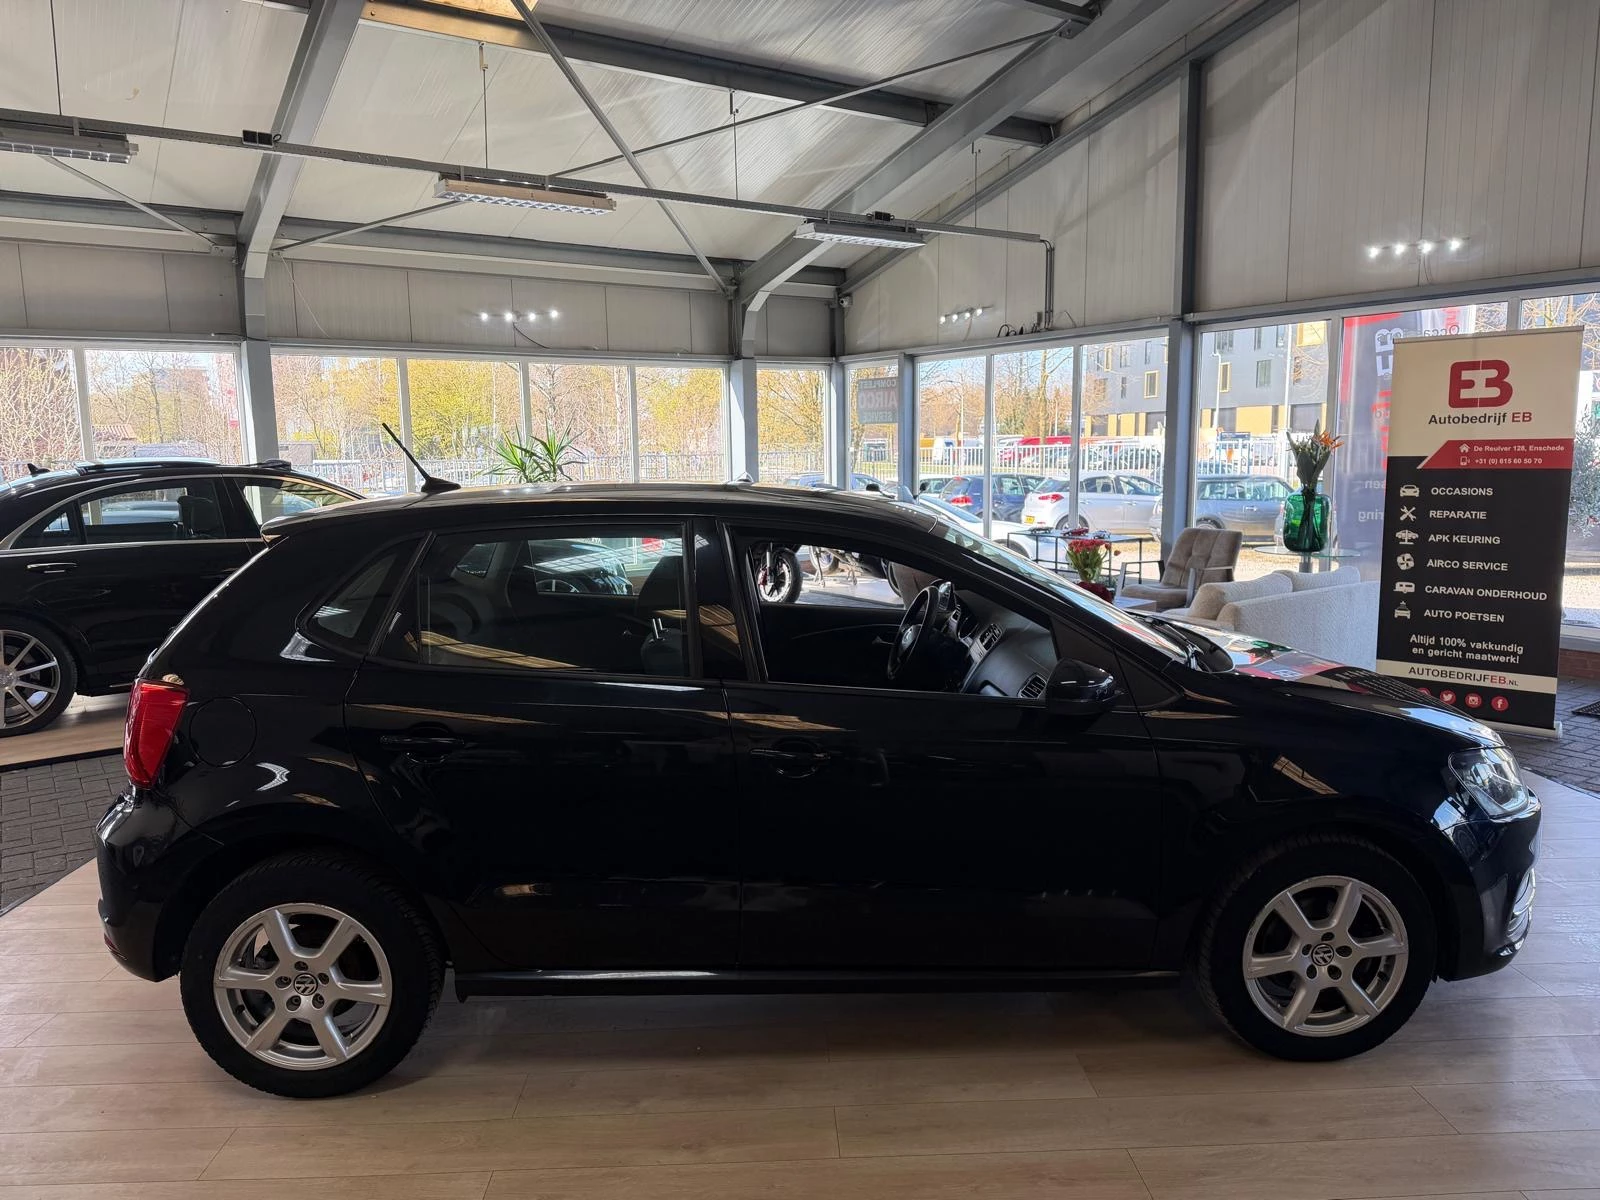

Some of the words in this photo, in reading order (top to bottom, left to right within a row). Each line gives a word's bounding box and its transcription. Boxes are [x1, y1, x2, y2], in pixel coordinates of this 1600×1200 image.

[1448, 359, 1514, 409] EB
[1428, 412, 1508, 426] Autobedrijf
[1511, 411, 1533, 423] EB
[1488, 457, 1498, 465] (0)
[1430, 487, 1494, 496] OCCASIONS
[1429, 510, 1487, 519] REPARATIE
[1428, 534, 1450, 543] APK
[1452, 535, 1501, 545] KEURING
[1426, 559, 1460, 569] AIRCO
[1462, 561, 1509, 571] SERVICE
[1425, 585, 1474, 596] CARAVAN
[1476, 588, 1548, 601] ONDERHOUD
[1423, 609, 1453, 619] AUTO
[1454, 611, 1505, 623] POETSEN
[1409, 634, 1436, 646] Altijd
[1440, 636, 1467, 648] 100%
[1469, 641, 1525, 655] vakkundig
[1412, 647, 1425, 655] en
[1427, 647, 1463, 658] gericht
[1465, 651, 1520, 664] maatwerk!
[1408, 666, 1519, 687] AUTOBEDRIJFEB.NL
